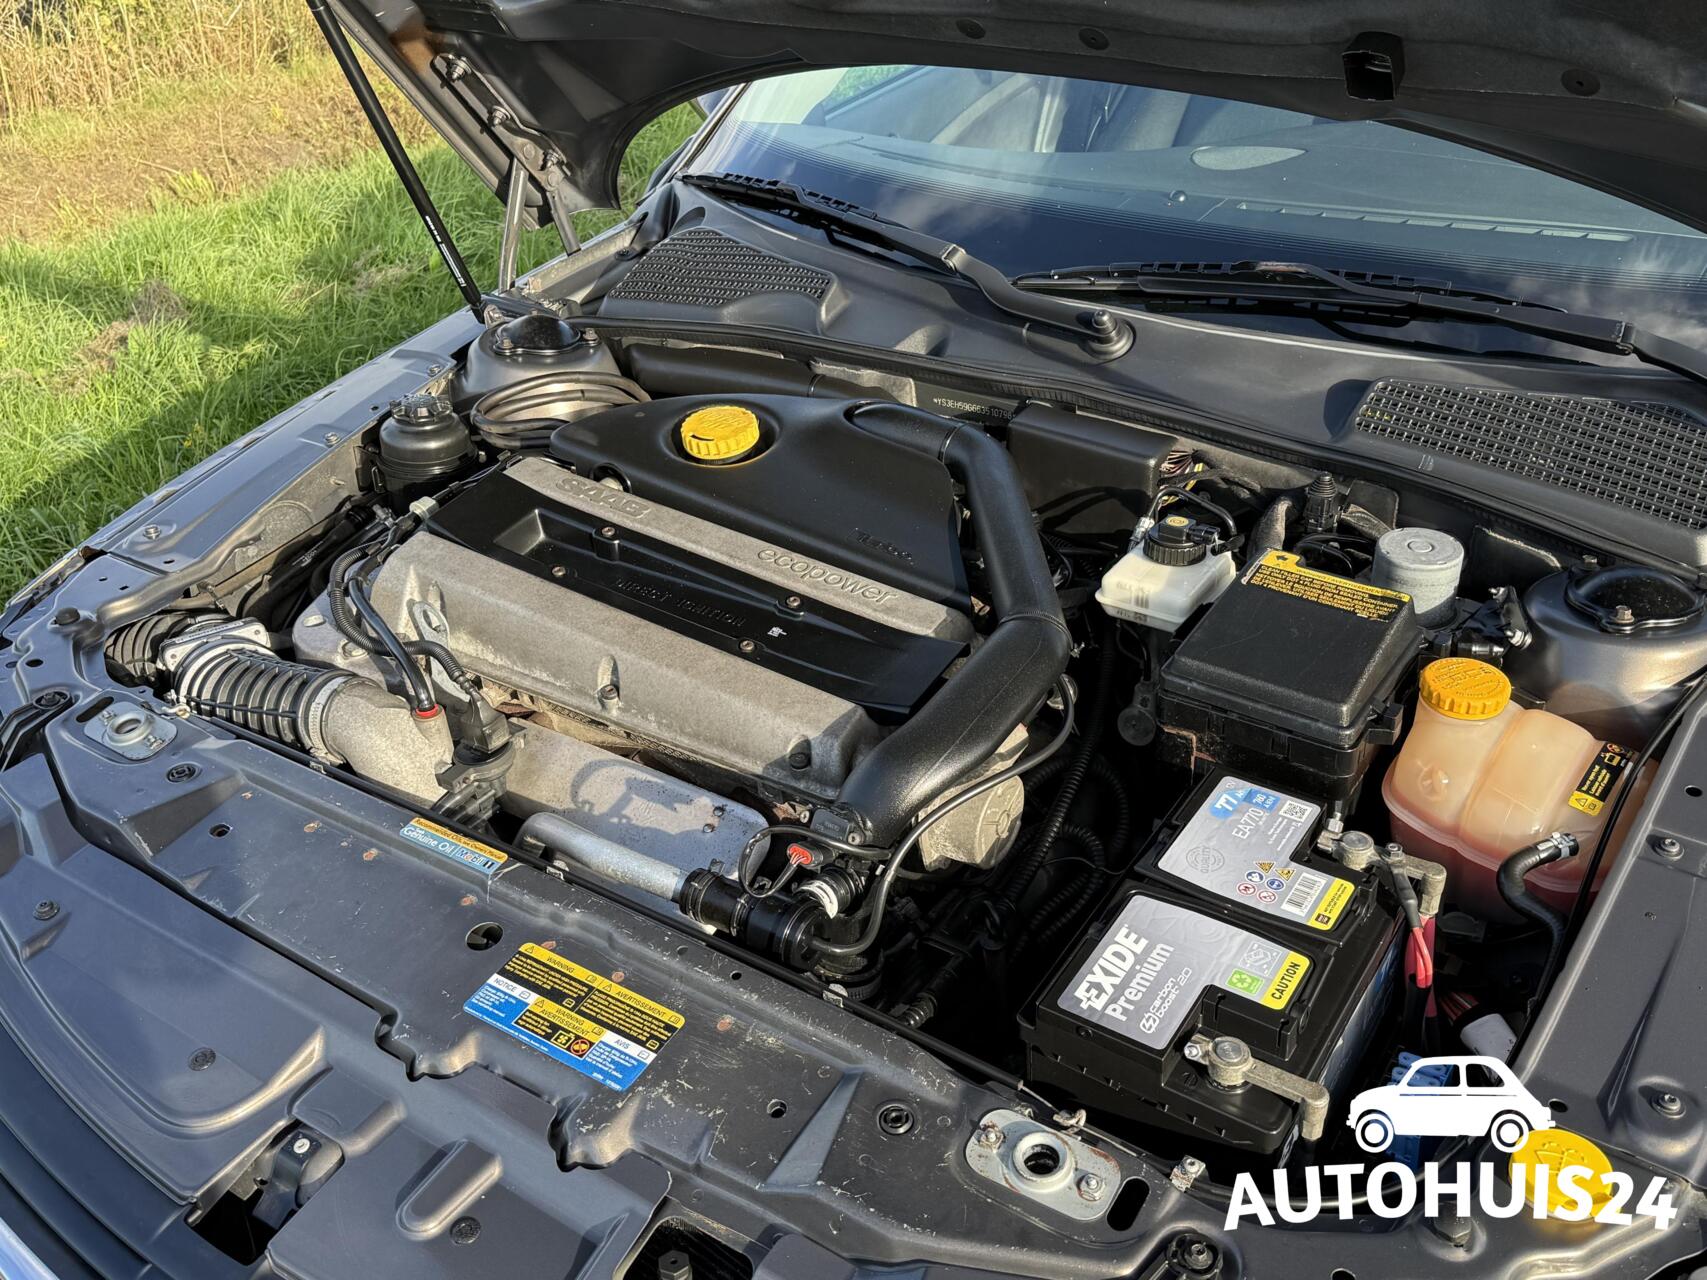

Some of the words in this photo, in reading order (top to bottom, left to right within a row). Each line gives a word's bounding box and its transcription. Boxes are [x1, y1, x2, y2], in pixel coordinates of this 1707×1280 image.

[555, 476, 651, 518] SAAB
[757, 549, 899, 605] ecopower
[1261, 565, 1280, 573] CLEAN
[1214, 793, 1238, 811] 77
[1232, 807, 1264, 839] EA770
[403, 827, 438, 847] Genuine
[439, 842, 455, 853] Oil
[456, 849, 484, 865] Mobil
[547, 956, 575, 973] WARNING
[1074, 926, 1149, 1012] EXIDE
[493, 977, 517, 993] NOTICE
[1105, 943, 1175, 1022] Premium
[1270, 961, 1301, 1000] CAUTION
[616, 990, 666, 1018] AVERTISSEMENT
[1150, 977, 1176, 1013] carbon
[1155, 985, 1180, 1018] boost
[540, 1008, 591, 1037] AVERTISSEMENT
[555, 1008, 585, 1026] WARNING
[614, 1039, 630, 1050] AVIS
